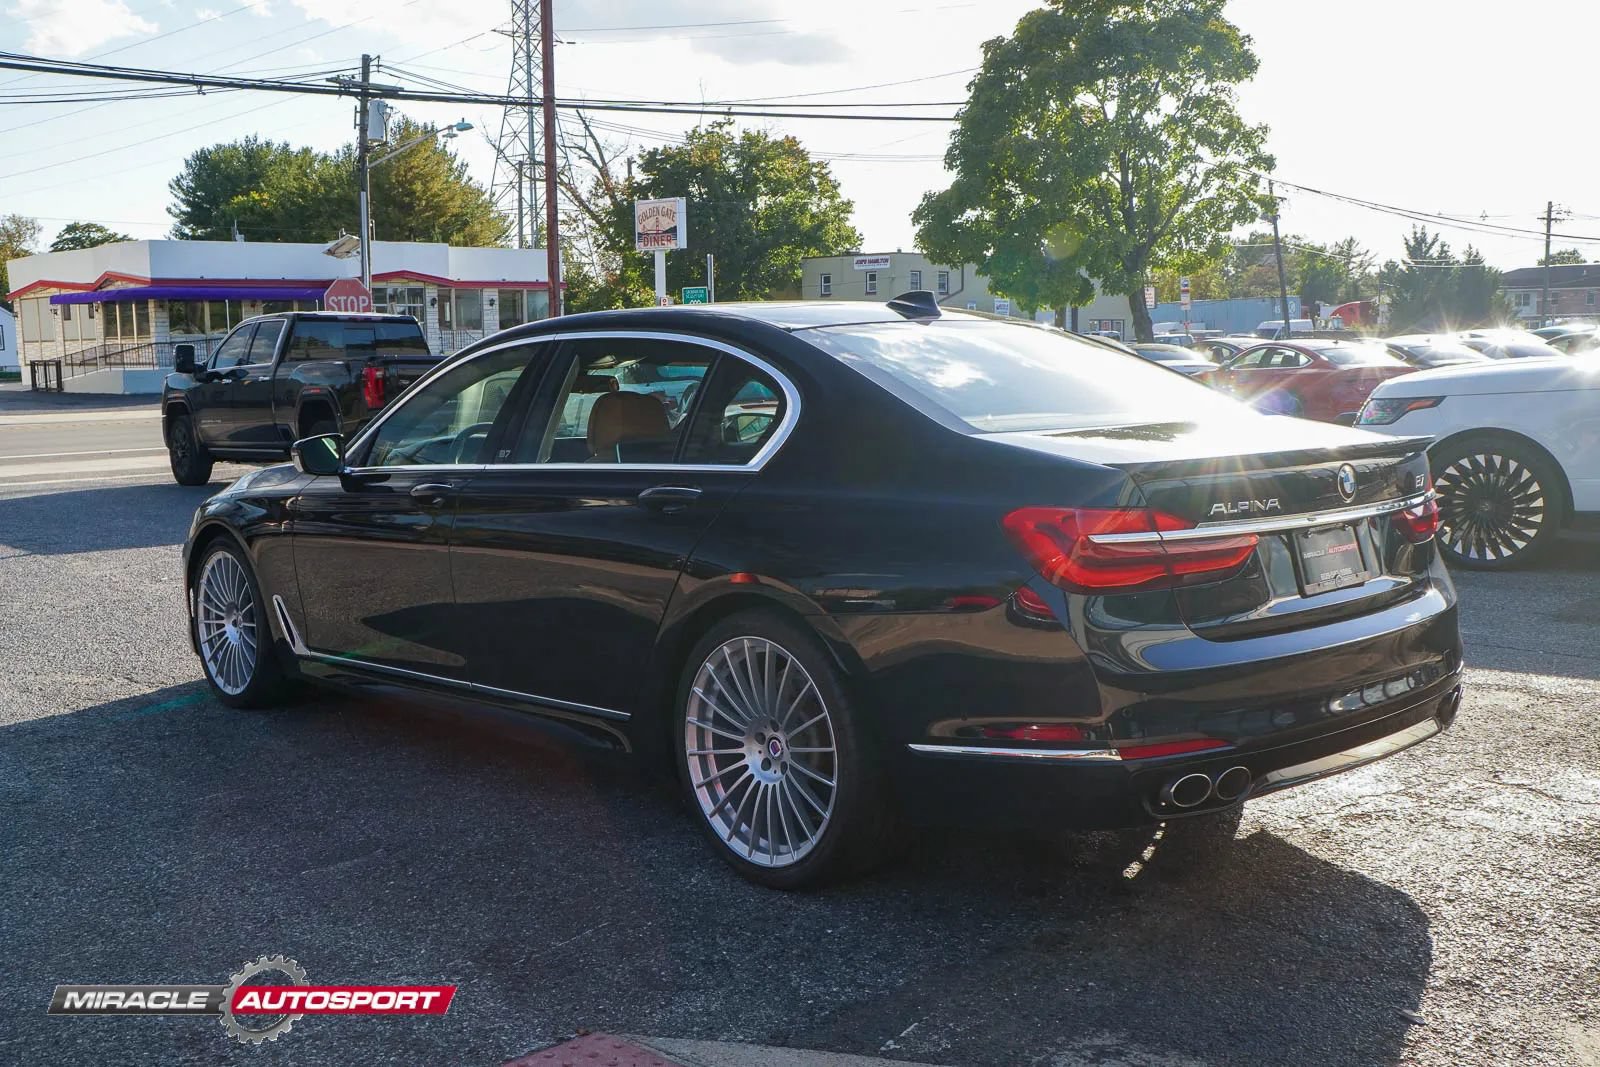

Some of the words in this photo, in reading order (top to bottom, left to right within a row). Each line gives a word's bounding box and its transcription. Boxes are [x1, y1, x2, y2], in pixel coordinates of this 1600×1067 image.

[638, 207, 660, 225] GOLDEN
[661, 206, 676, 222] GATE
[643, 235, 672, 247] DINER
[328, 295, 369, 312] STOP
[1208, 498, 1281, 516] ALPINA
